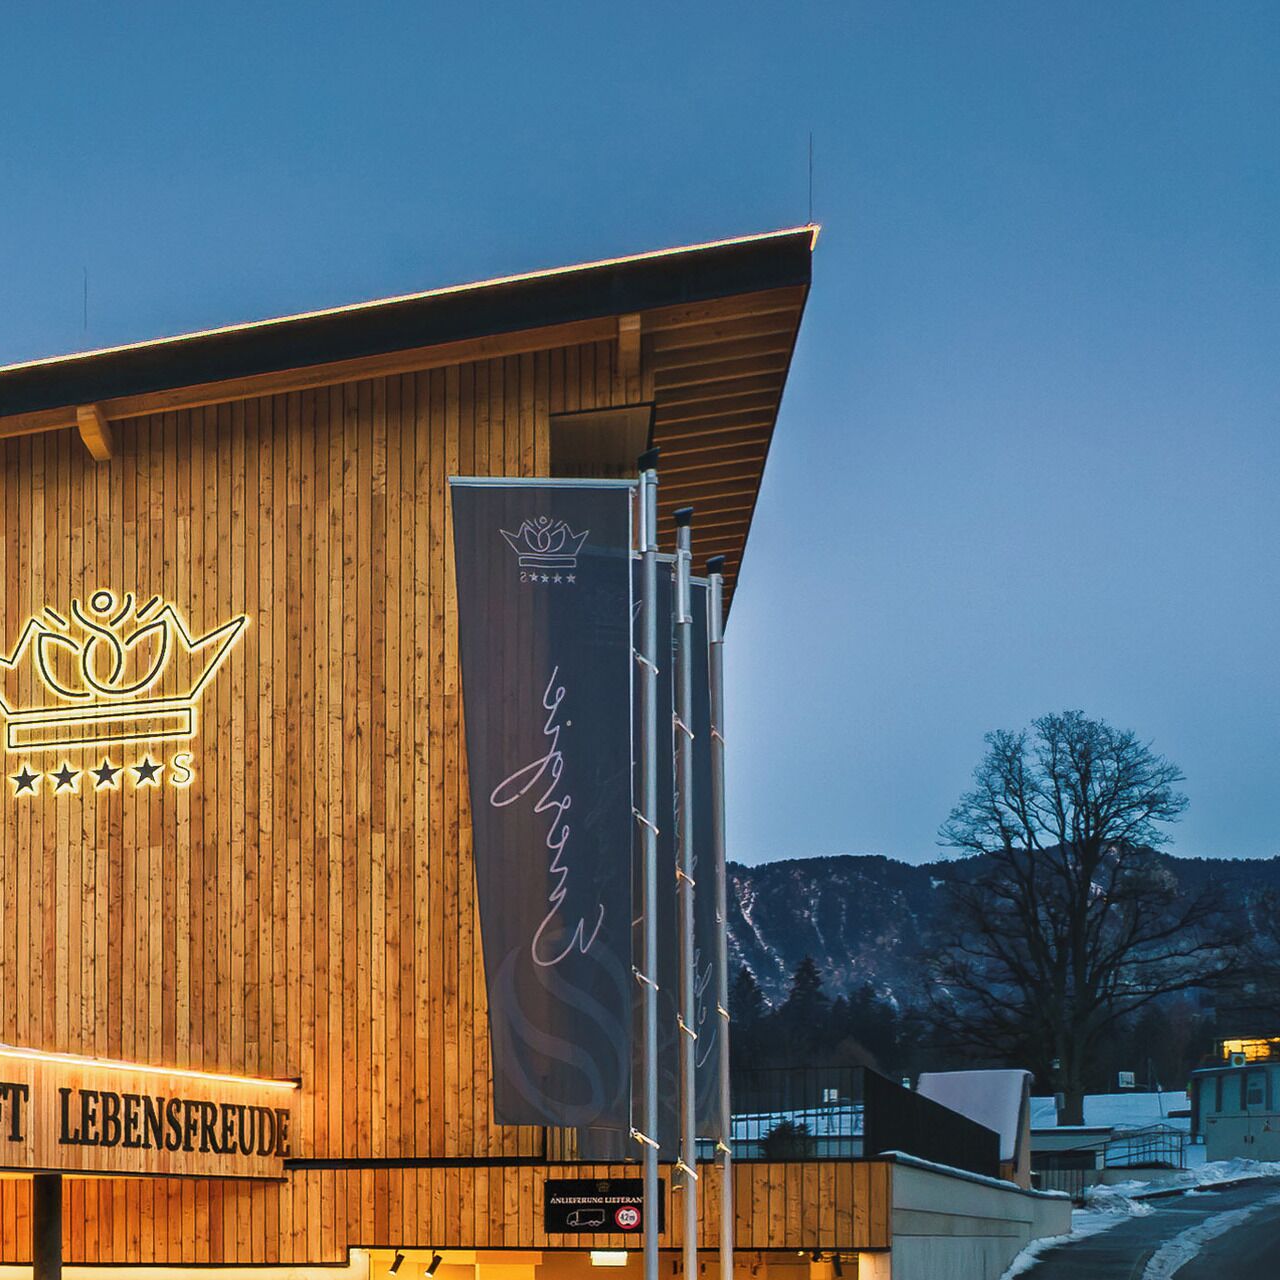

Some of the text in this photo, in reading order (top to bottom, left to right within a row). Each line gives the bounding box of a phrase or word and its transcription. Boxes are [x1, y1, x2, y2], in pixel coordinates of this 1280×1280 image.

[171, 752, 192, 785] S
[58, 1087, 292, 1158] LEBENSFREUDE
[604, 1196, 643, 1204] LIEFERAN
